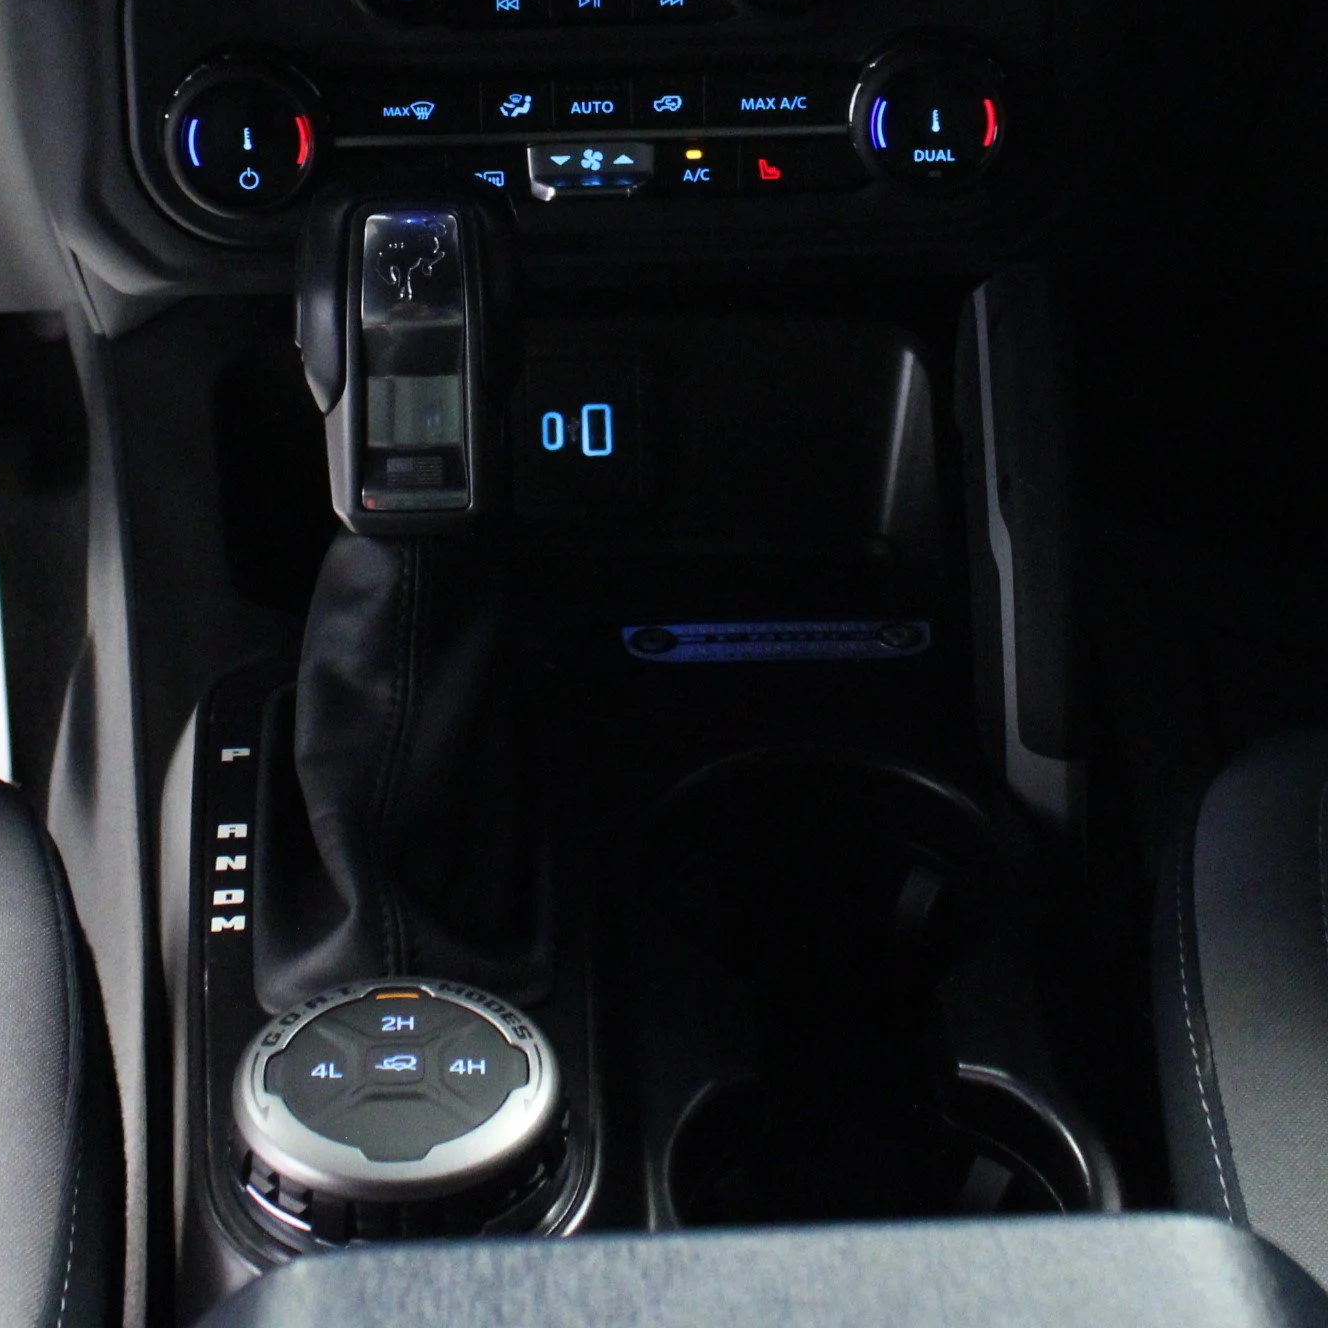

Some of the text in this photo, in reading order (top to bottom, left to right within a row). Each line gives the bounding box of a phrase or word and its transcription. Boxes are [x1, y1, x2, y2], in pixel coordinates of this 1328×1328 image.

[571, 101, 614, 114] AUTO
[741, 96, 808, 111] MAX A/C
[383, 107, 410, 118] MAX
[914, 150, 955, 163] DUAL
[683, 169, 710, 183] A/C
[221, 748, 251, 762] P
[215, 855, 247, 871] N
[211, 915, 246, 932] M
[438, 983, 534, 1040] MODES
[381, 1015, 414, 1032] 2H
[311, 1062, 343, 1079] 4L
[449, 1058, 486, 1075] 4H
